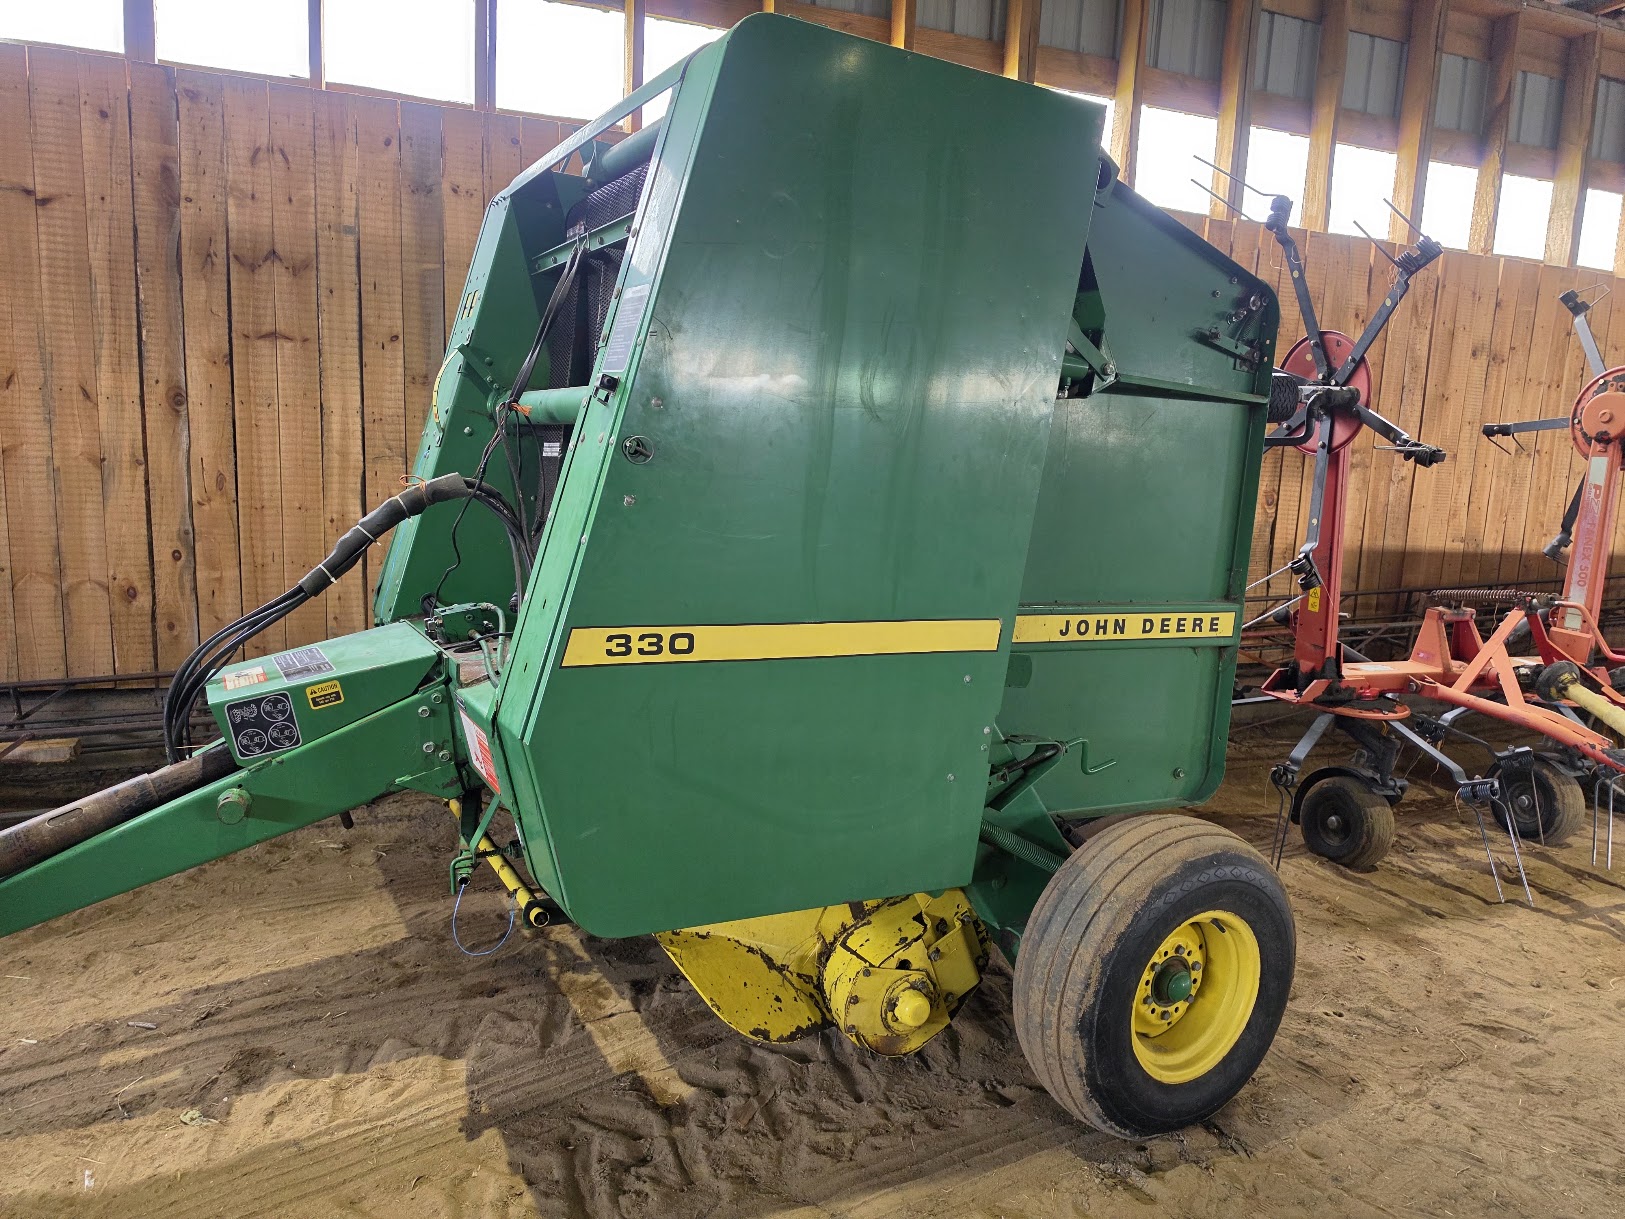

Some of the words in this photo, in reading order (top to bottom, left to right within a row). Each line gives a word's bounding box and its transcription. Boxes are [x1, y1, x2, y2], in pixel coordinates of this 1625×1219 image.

[1577, 564, 1589, 588] 500
[1059, 618, 1126, 637] JOHN
[1142, 616, 1220, 634] DEERE
[605, 632, 695, 657] 330
[317, 683, 338, 693] CAUTION
